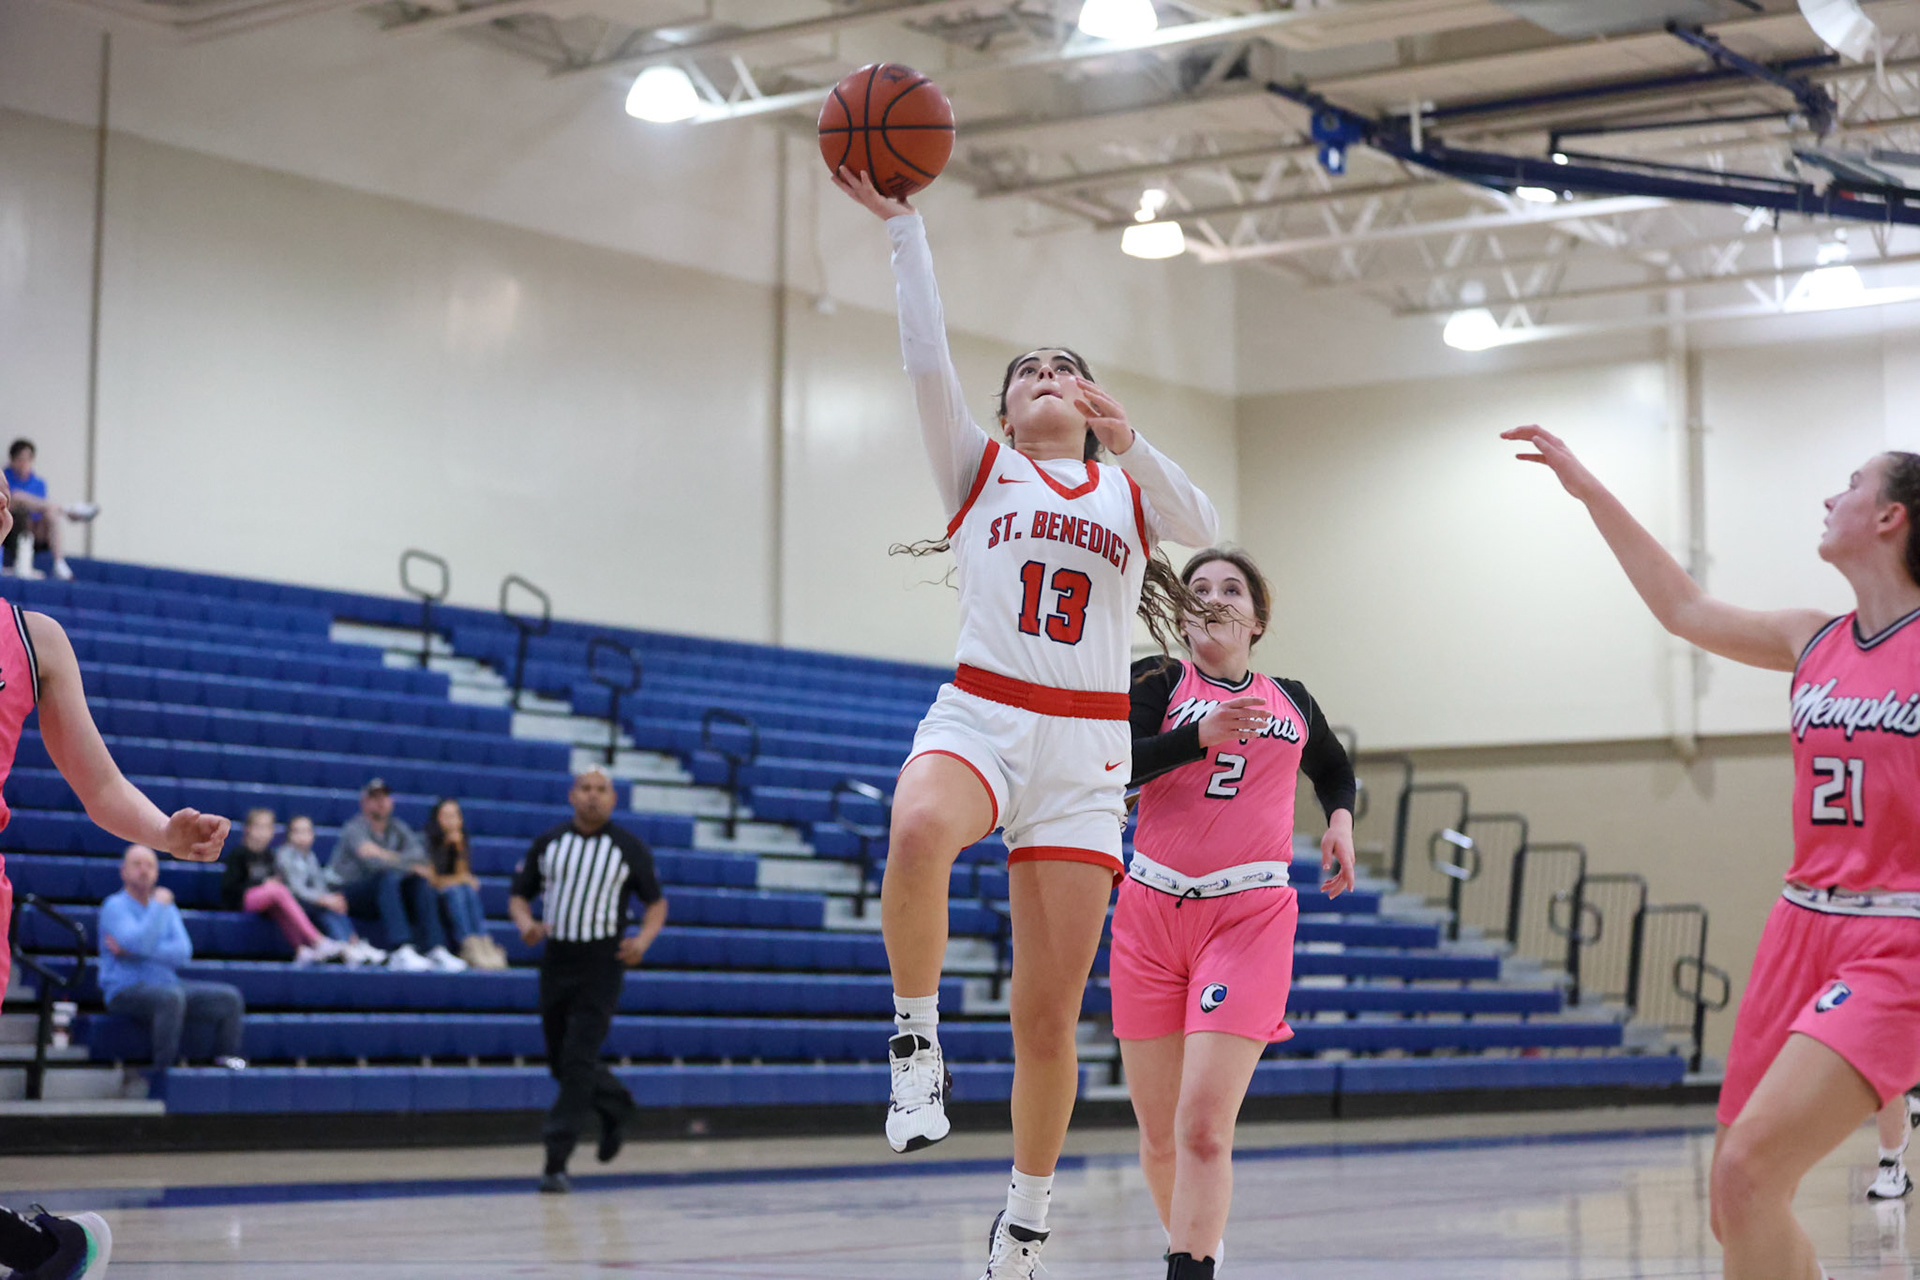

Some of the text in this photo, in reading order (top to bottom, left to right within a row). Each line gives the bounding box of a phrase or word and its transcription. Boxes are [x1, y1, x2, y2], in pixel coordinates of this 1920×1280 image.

[988, 510, 1131, 576] ST. BENEDICT
[1018, 560, 1092, 646] 13
[1792, 678, 1920, 743] Memphis
[1204, 752, 1247, 799] 2
[1811, 756, 1865, 827] 21
